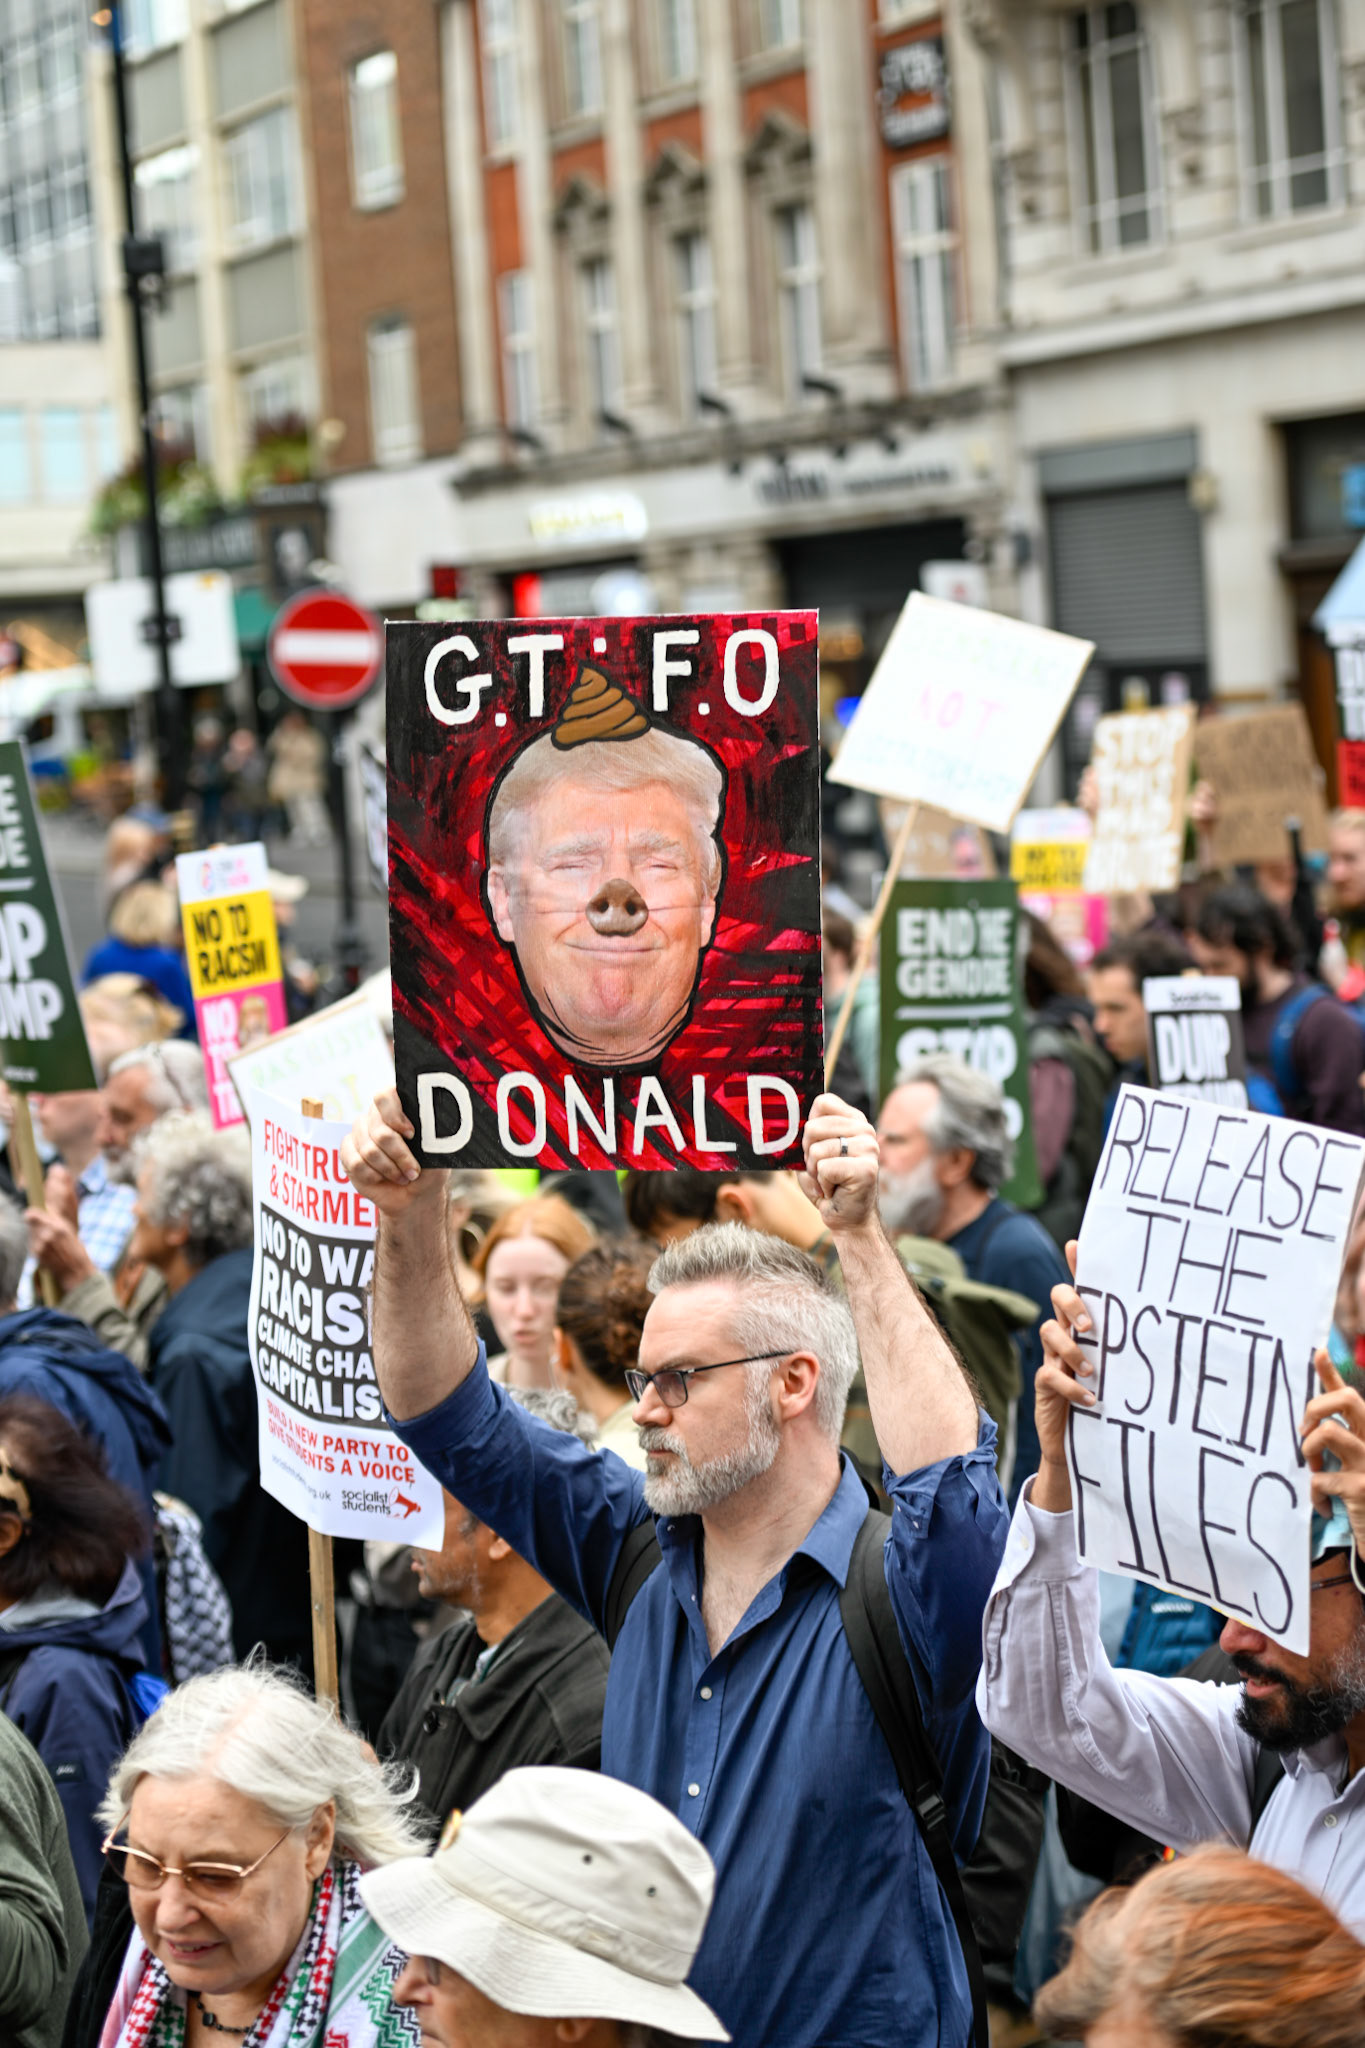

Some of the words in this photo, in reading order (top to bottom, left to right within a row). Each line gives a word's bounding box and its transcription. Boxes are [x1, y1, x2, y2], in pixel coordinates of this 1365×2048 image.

[193, 909, 221, 946] NO
[228, 904, 248, 939] TO
[417, 1070, 800, 1158] DONALD
[264, 1119, 299, 1172] FIGHT
[301, 1141, 350, 1185] TRU
[1100, 1093, 1362, 1243] RELEASE
[270, 1164, 279, 1200] &
[282, 1172, 378, 1228] STARME
[261, 1211, 286, 1261] NO
[288, 1229, 312, 1278] TO
[318, 1244, 374, 1288] WA
[1127, 1206, 1283, 1326] THE
[261, 1254, 374, 1347] RACIS
[257, 1313, 312, 1372] CLIMATE
[315, 1347, 376, 1381] CHA
[258, 1347, 386, 1423] CAPITALIS
[285, 1432, 335, 1473] STUDENTS
[341, 1459, 353, 1477] A
[359, 1460, 416, 1484] VOICE
[295, 1423, 318, 1449] NEW
[323, 1435, 381, 1458] PARTY
[386, 1445, 409, 1463] TO
[341, 1489, 389, 1502] socialist
[341, 1500, 391, 1516] students
[1069, 1404, 1297, 1635] FILES
